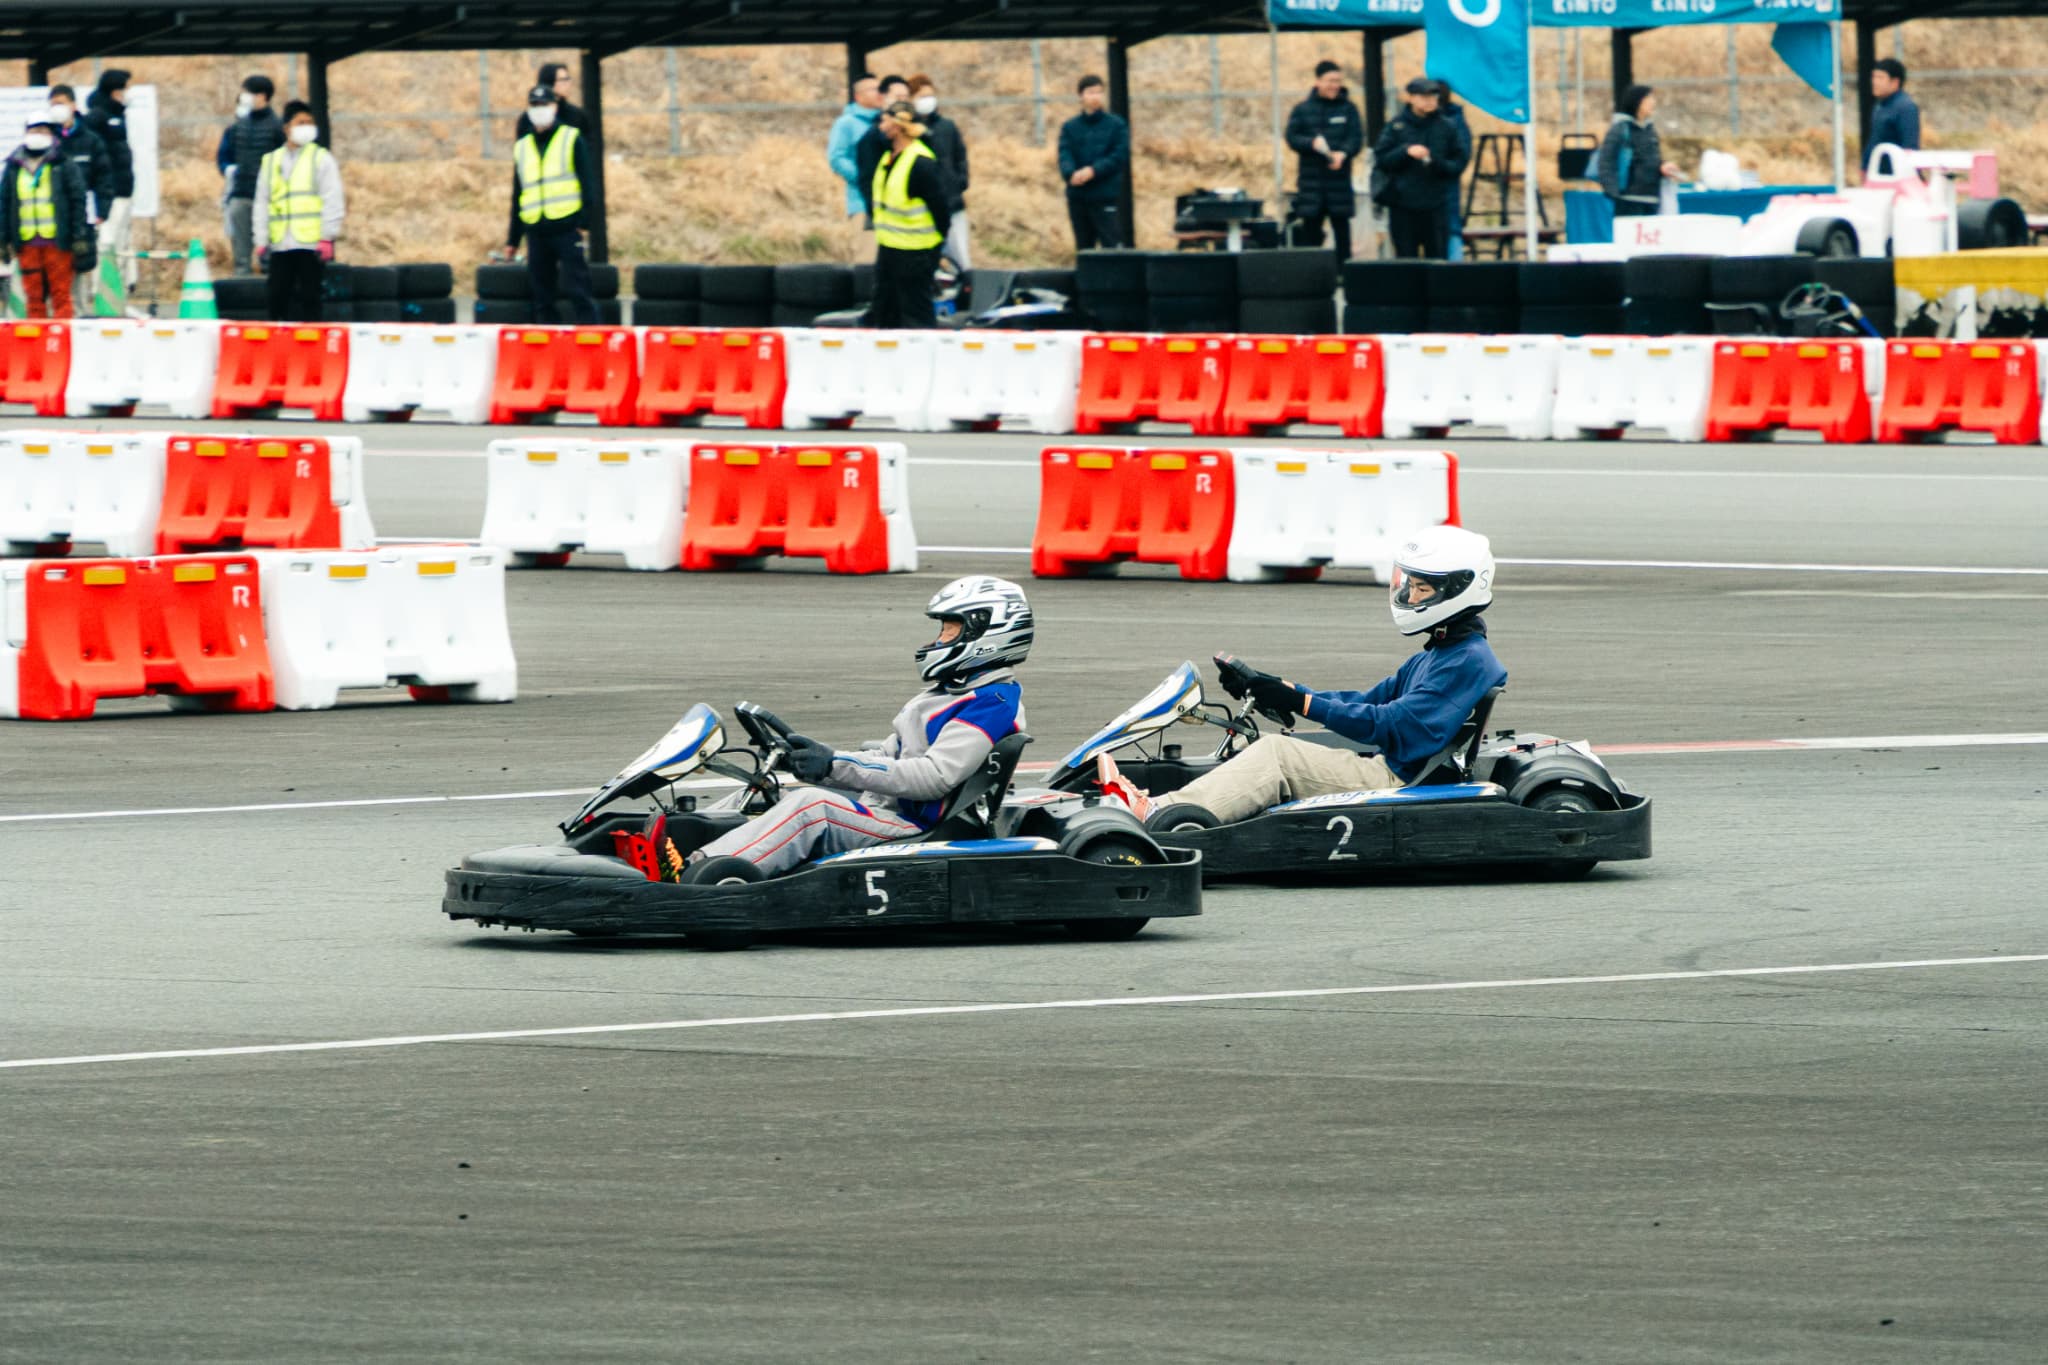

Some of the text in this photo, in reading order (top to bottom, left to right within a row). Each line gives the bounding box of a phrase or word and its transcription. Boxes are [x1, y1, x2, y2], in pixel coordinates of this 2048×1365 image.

[1552, 0, 1617, 14] KINTO
[1353, 352, 1367, 369] R
[296, 459, 311, 478] R
[843, 467, 859, 488] R
[1195, 473, 1212, 494] R
[232, 585, 250, 608] R
[987, 751, 1001, 775] 5
[1325, 815, 1358, 861] 2
[865, 870, 889, 916] 5
